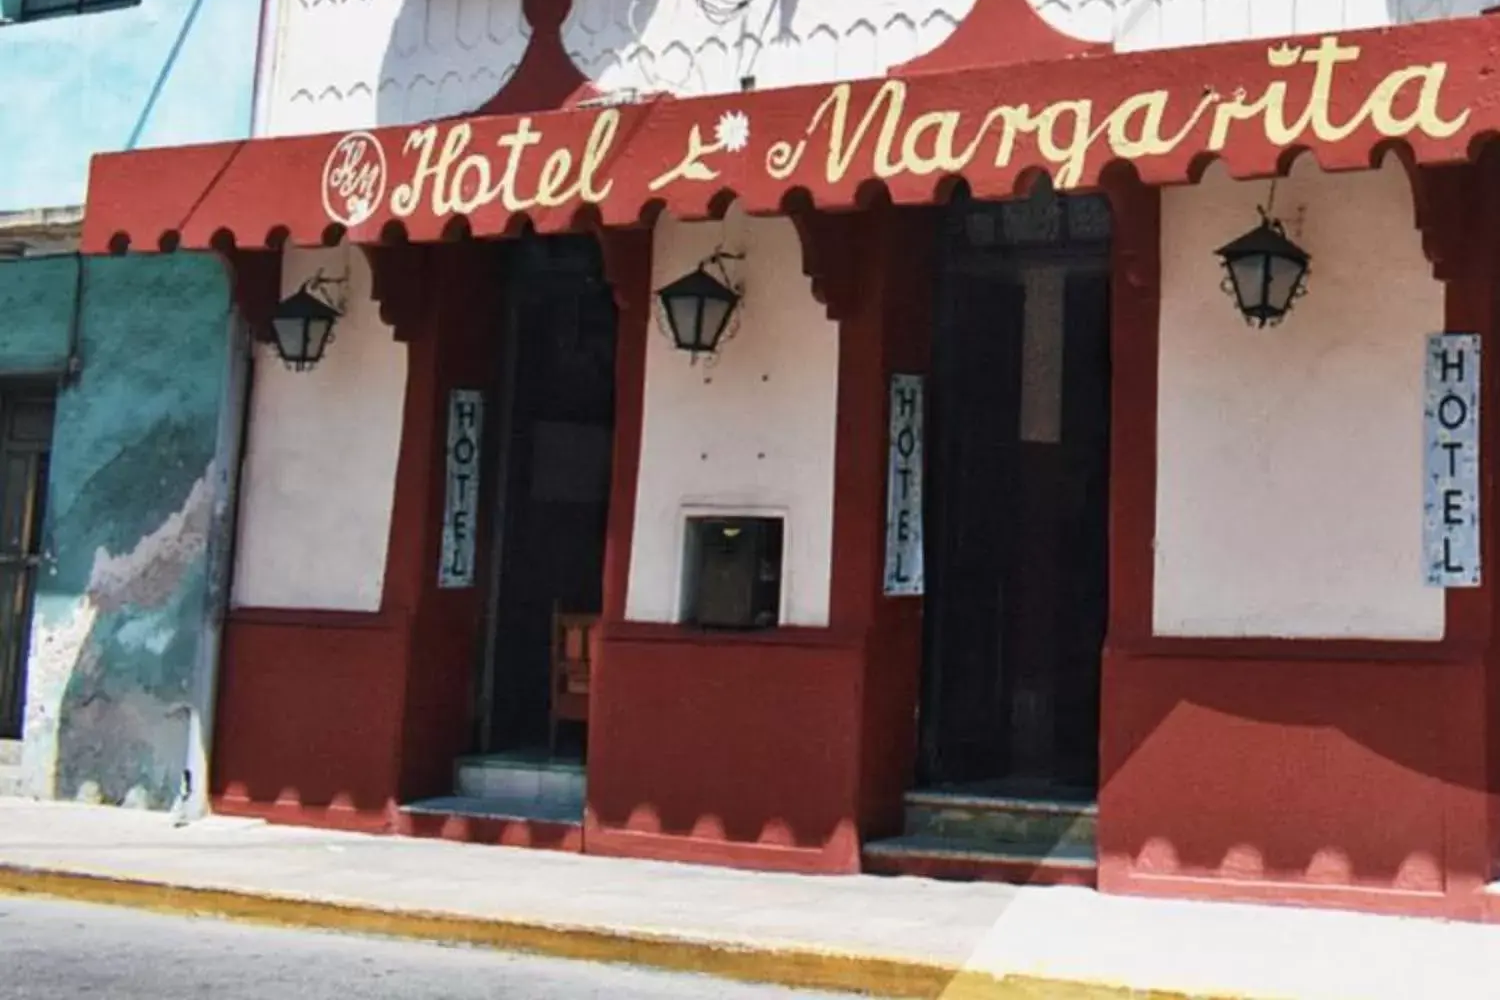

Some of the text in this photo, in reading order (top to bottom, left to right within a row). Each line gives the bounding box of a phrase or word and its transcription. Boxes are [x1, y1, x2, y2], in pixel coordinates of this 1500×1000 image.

[390, 36, 1472, 217] Hotel Margarita
[451, 402, 476, 576] HOTEL
[893, 388, 917, 582] HOTEL
[1439, 350, 1467, 573] HOTEL
